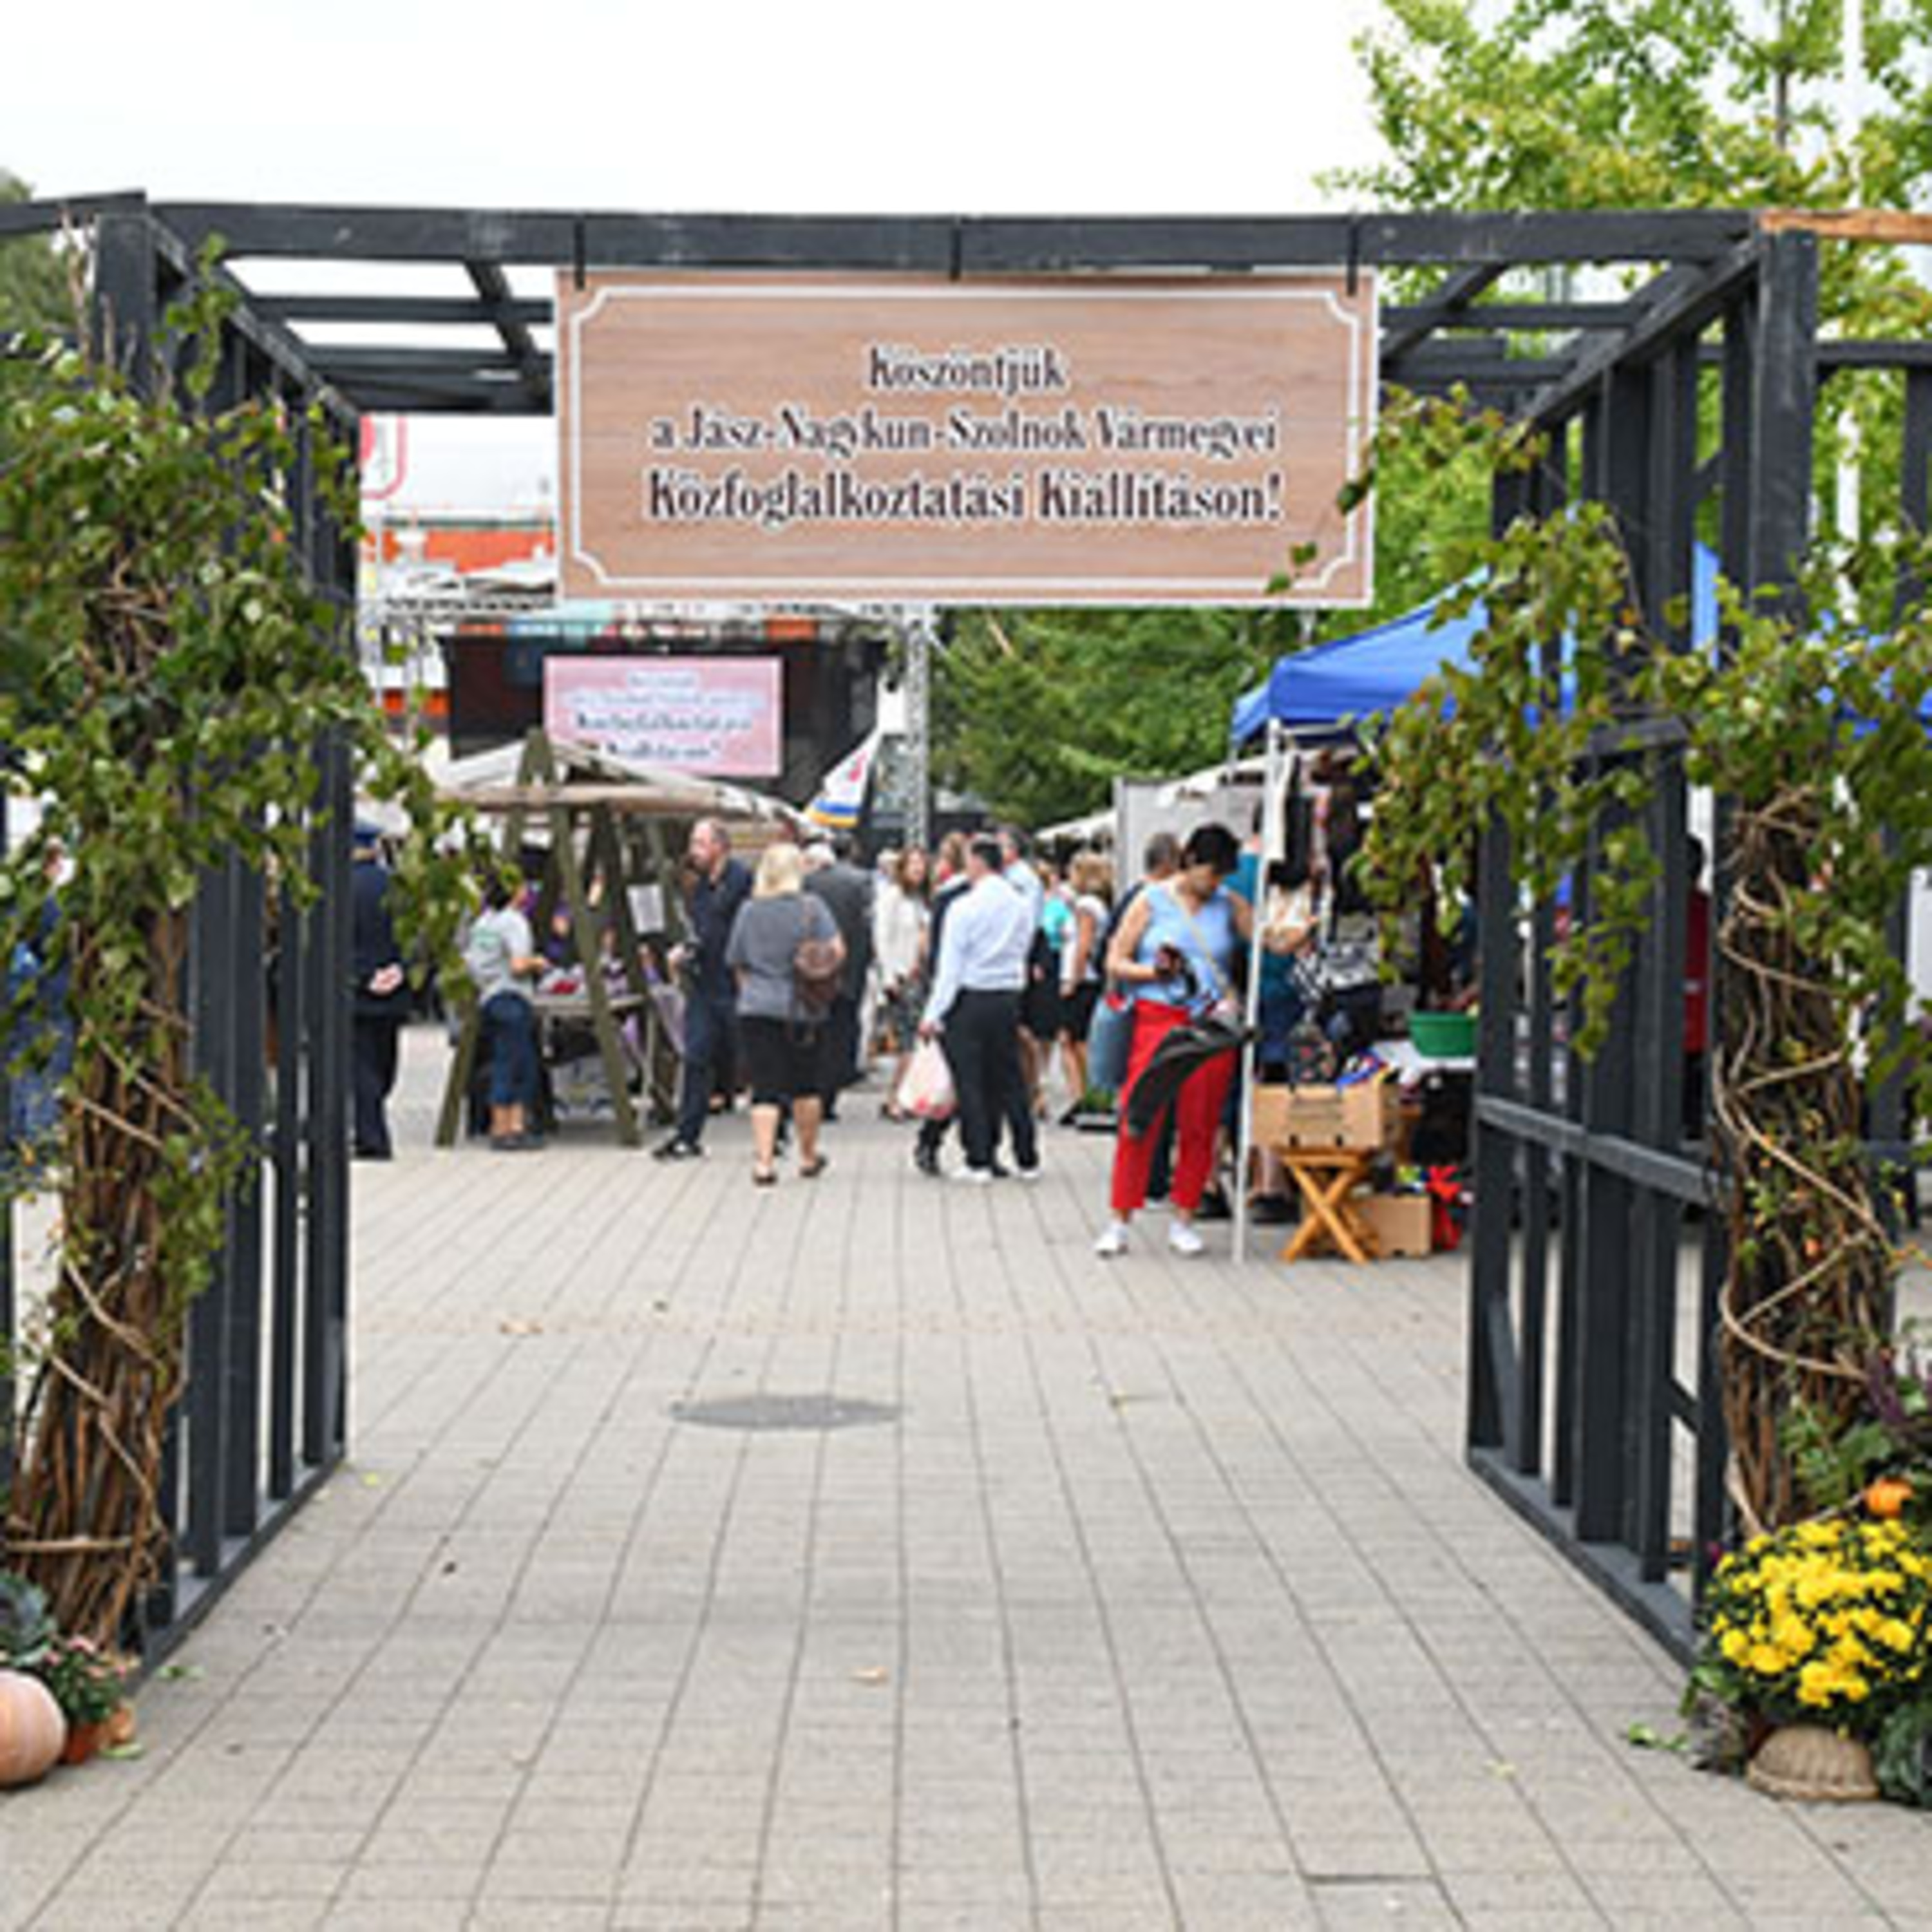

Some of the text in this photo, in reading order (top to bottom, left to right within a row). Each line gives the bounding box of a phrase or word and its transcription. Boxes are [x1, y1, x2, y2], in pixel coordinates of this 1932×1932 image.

[652, 421, 674, 448] a
[1096, 409, 1277, 459] Vármegyei
[650, 471, 1281, 525] Közfoglalkoztatási Kiállításon!
